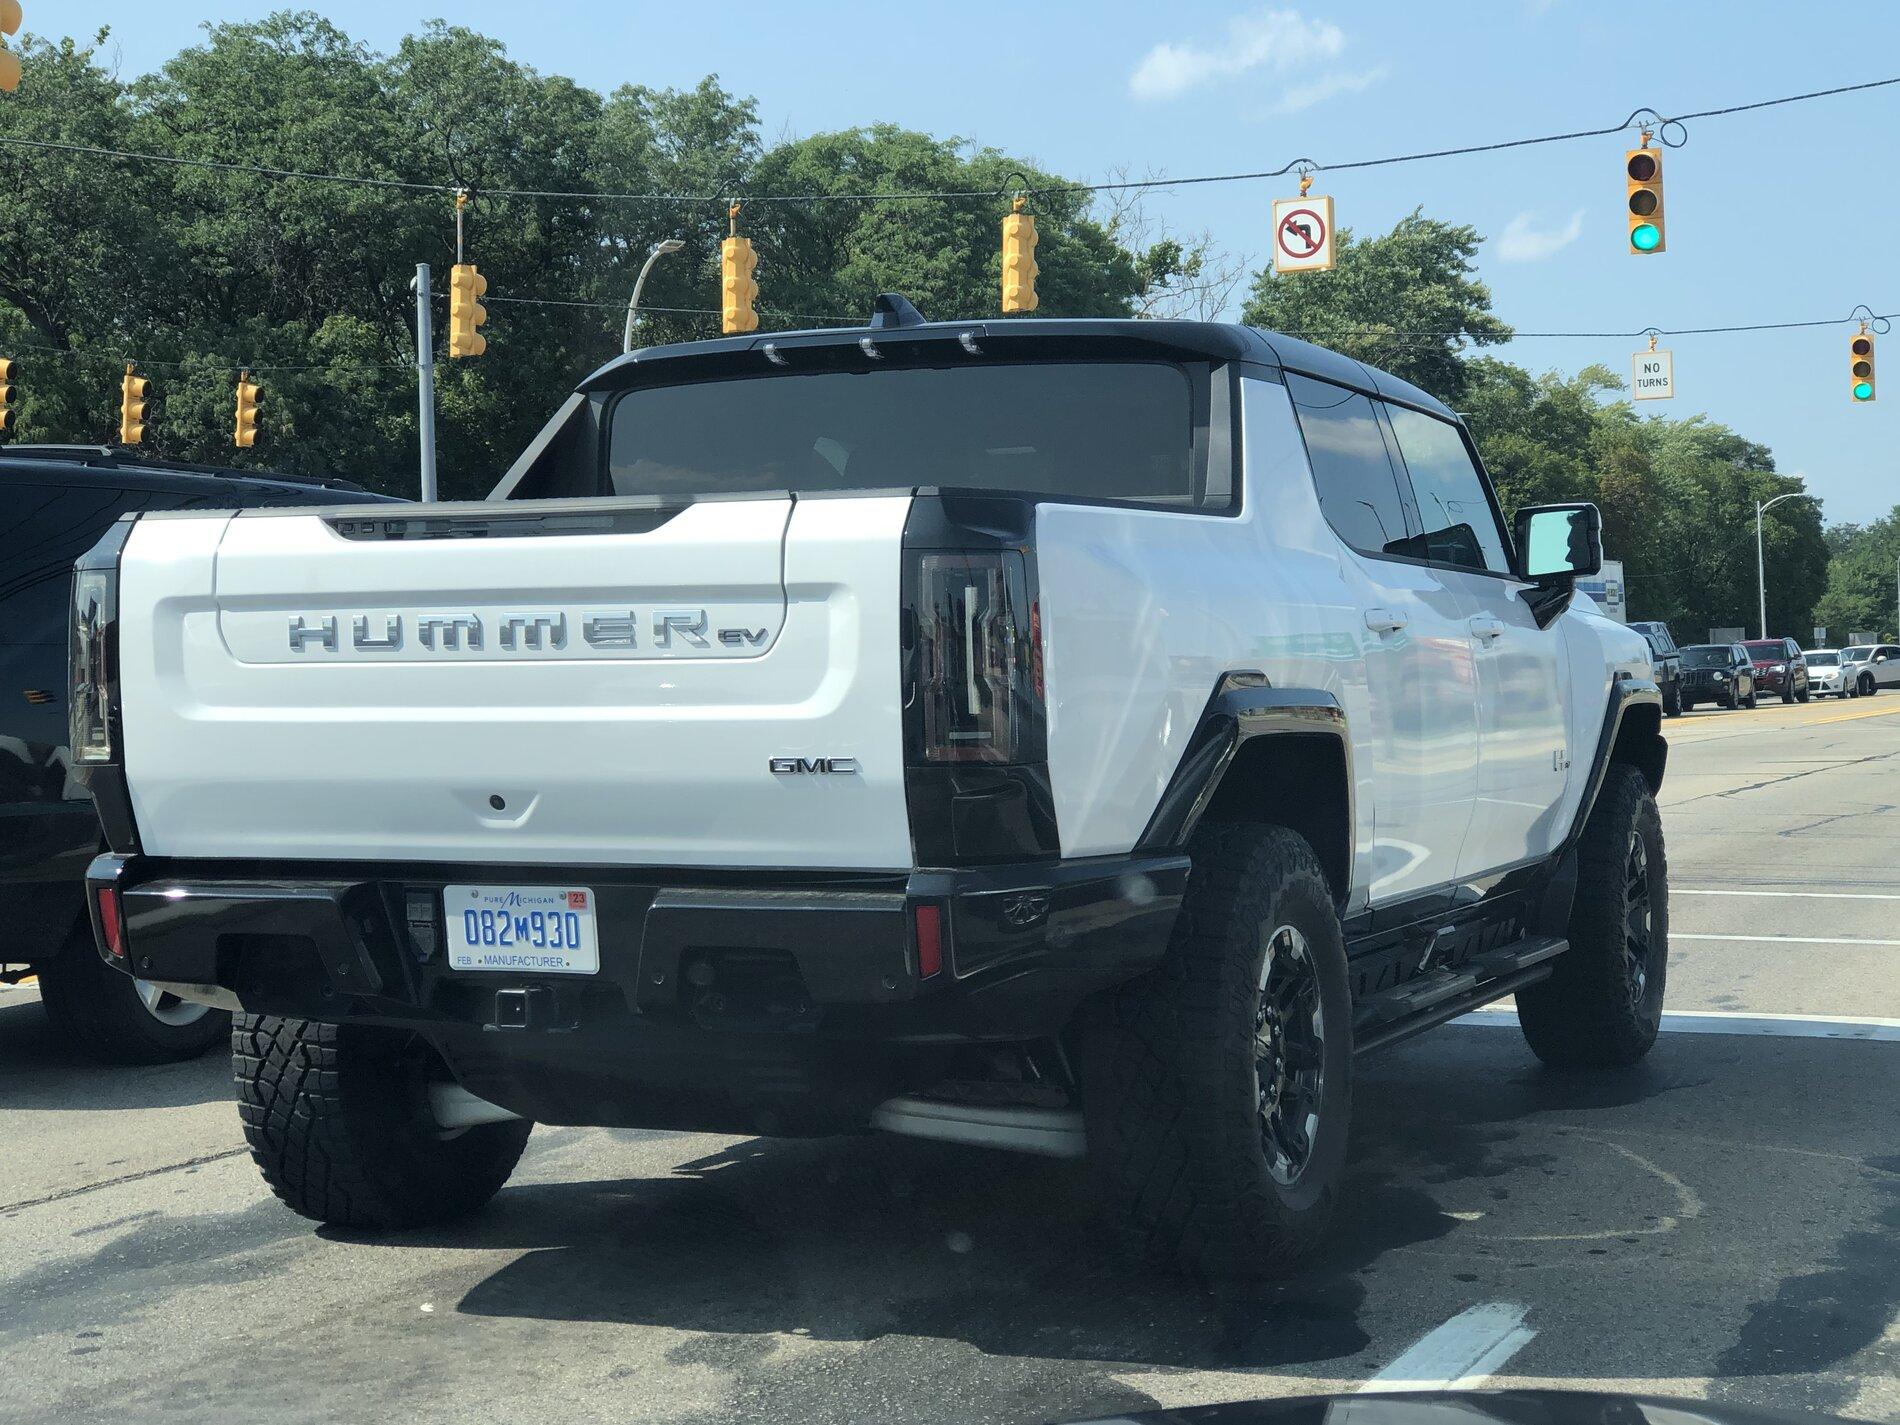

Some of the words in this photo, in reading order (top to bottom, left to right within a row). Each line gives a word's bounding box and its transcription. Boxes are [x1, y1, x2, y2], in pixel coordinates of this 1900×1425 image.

[1643, 362, 1660, 374] NO
[1637, 377, 1669, 388] TURNS
[288, 609, 711, 653] HUMMER
[717, 627, 769, 647] EV
[768, 756, 858, 776] GMC
[484, 896, 504, 904] PURE
[572, 892, 586, 904] 23
[463, 908, 580, 949] 082M930
[457, 956, 472, 965] FEB
[484, 955, 564, 968] MANUFACTURER
